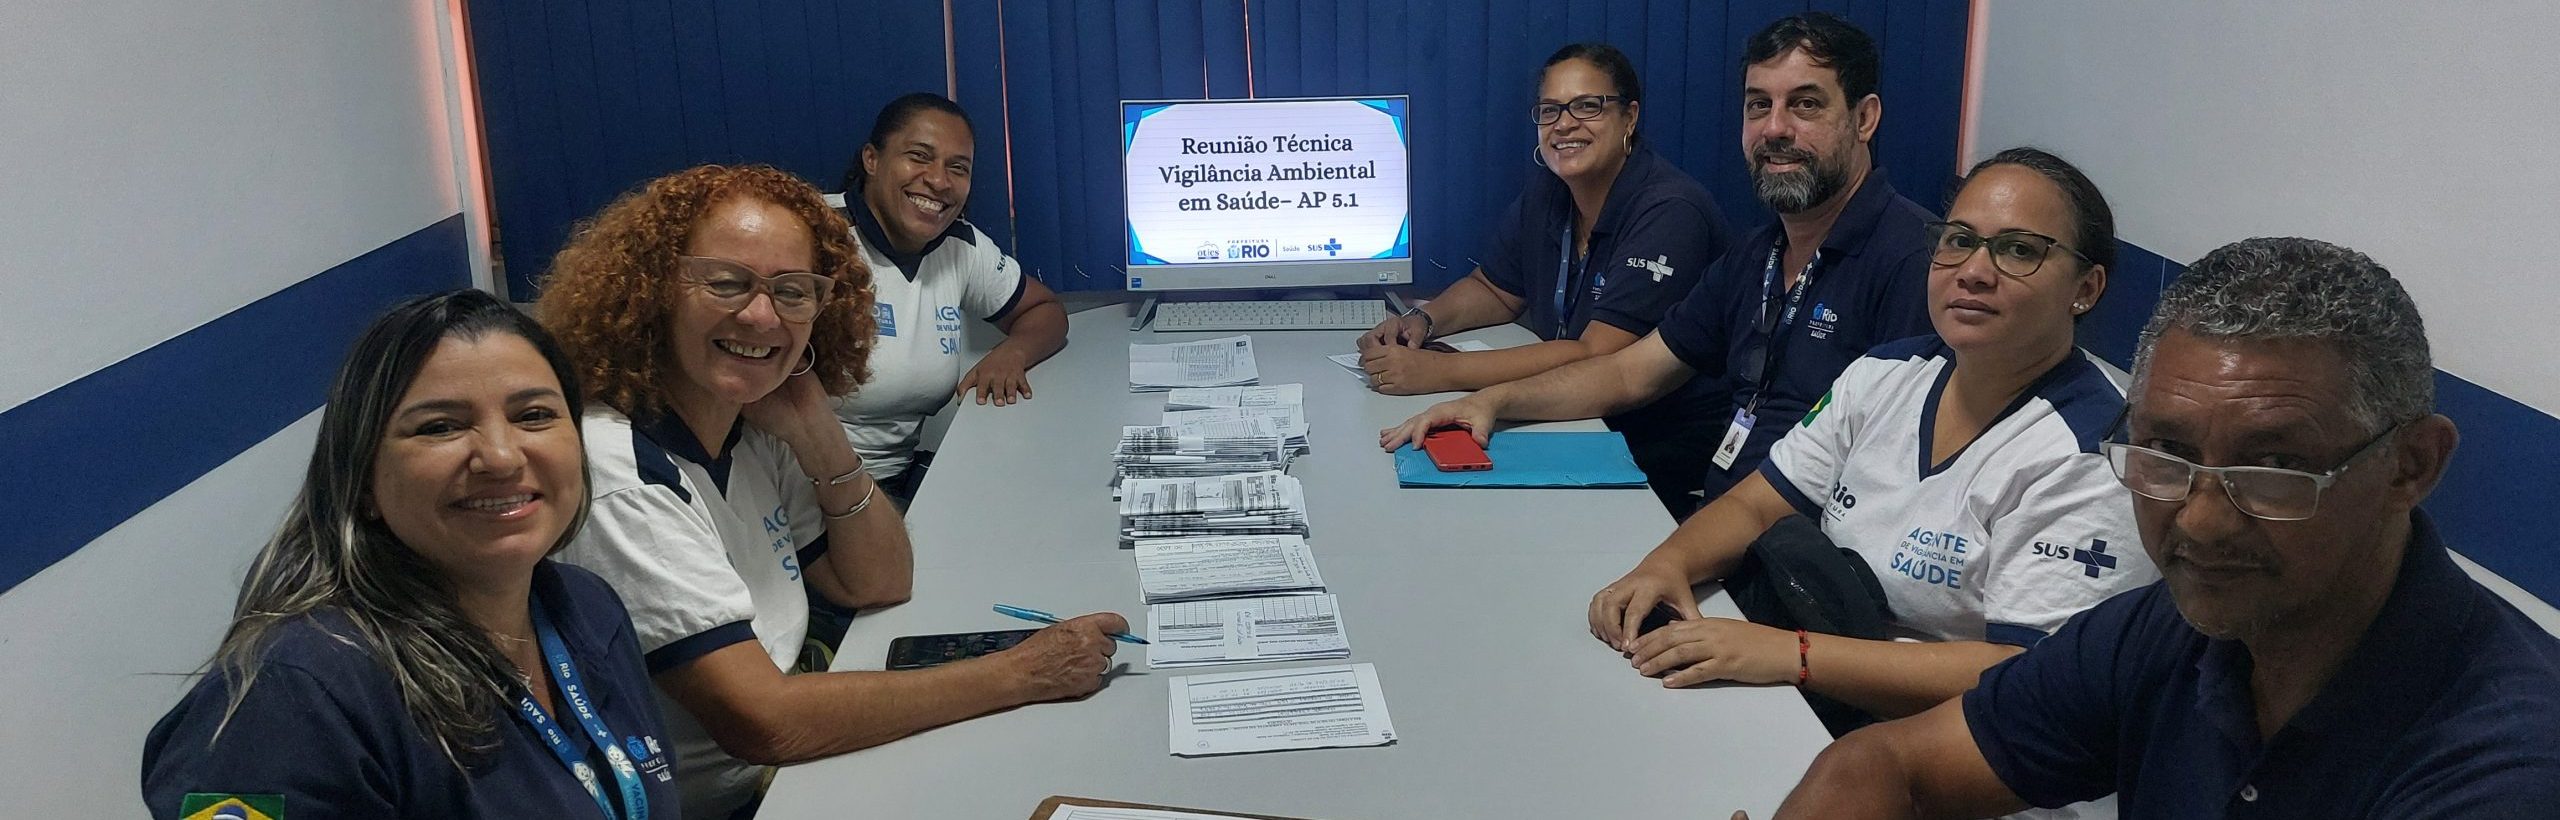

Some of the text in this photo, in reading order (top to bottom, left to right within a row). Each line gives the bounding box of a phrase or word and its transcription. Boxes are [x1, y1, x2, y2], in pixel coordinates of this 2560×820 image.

[1181, 133, 1353, 155] Reunião Técnica
[1158, 160, 1376, 188] Vigilância Ambiental
[1179, 197, 1212, 211] em
[1297, 191, 1327, 209] AP
[1332, 192, 1359, 208] 5.1
[1241, 244, 1270, 259] RIO
[1307, 244, 1323, 252] SUS
[1626, 257, 1646, 268] SUS
[1901, 540, 1911, 550] DE
[1950, 555, 1964, 567] EM
[2032, 541, 2070, 560] SUS
[1890, 551, 1962, 590] SAÚDE
[567, 684, 593, 720] SAÚDE
